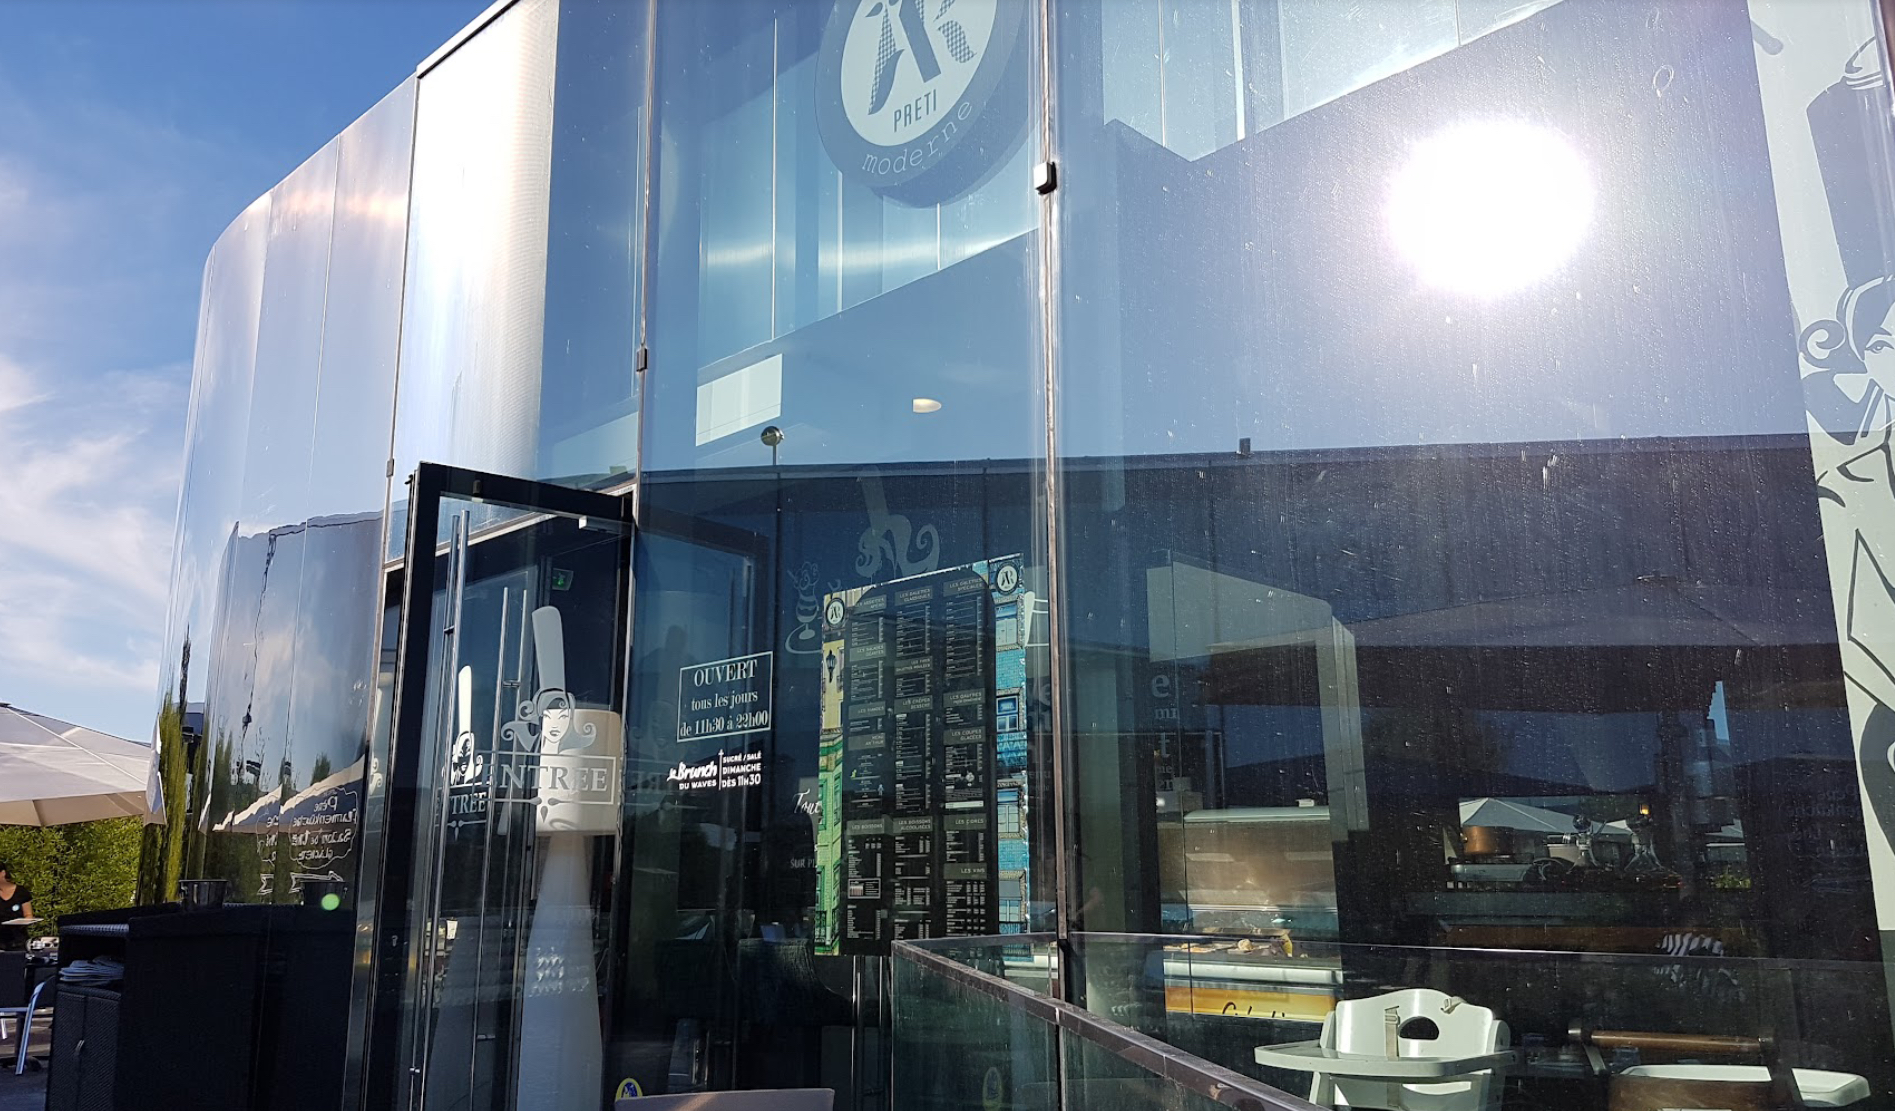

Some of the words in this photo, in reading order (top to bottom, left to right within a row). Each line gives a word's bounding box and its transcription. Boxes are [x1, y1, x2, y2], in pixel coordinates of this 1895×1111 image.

[893, 89, 938, 133] PRETI
[861, 100, 973, 176] moderne
[694, 659, 758, 687] OUVERT
[691, 697, 712, 712] tous
[714, 693, 729, 708] les
[729, 690, 758, 709] jours
[680, 722, 692, 737] de
[695, 716, 725, 735] 11h30
[727, 715, 733, 730] à
[736, 710, 768, 729] 22h00
[722, 753, 742, 763] SUCRÉ
[746, 750, 762, 760] SALÉ
[677, 760, 718, 780] Brunch
[722, 763, 762, 775] DIMANCHE
[679, 781, 690, 790] DU
[691, 779, 717, 788] WAVES
[722, 776, 737, 788] DÈS
